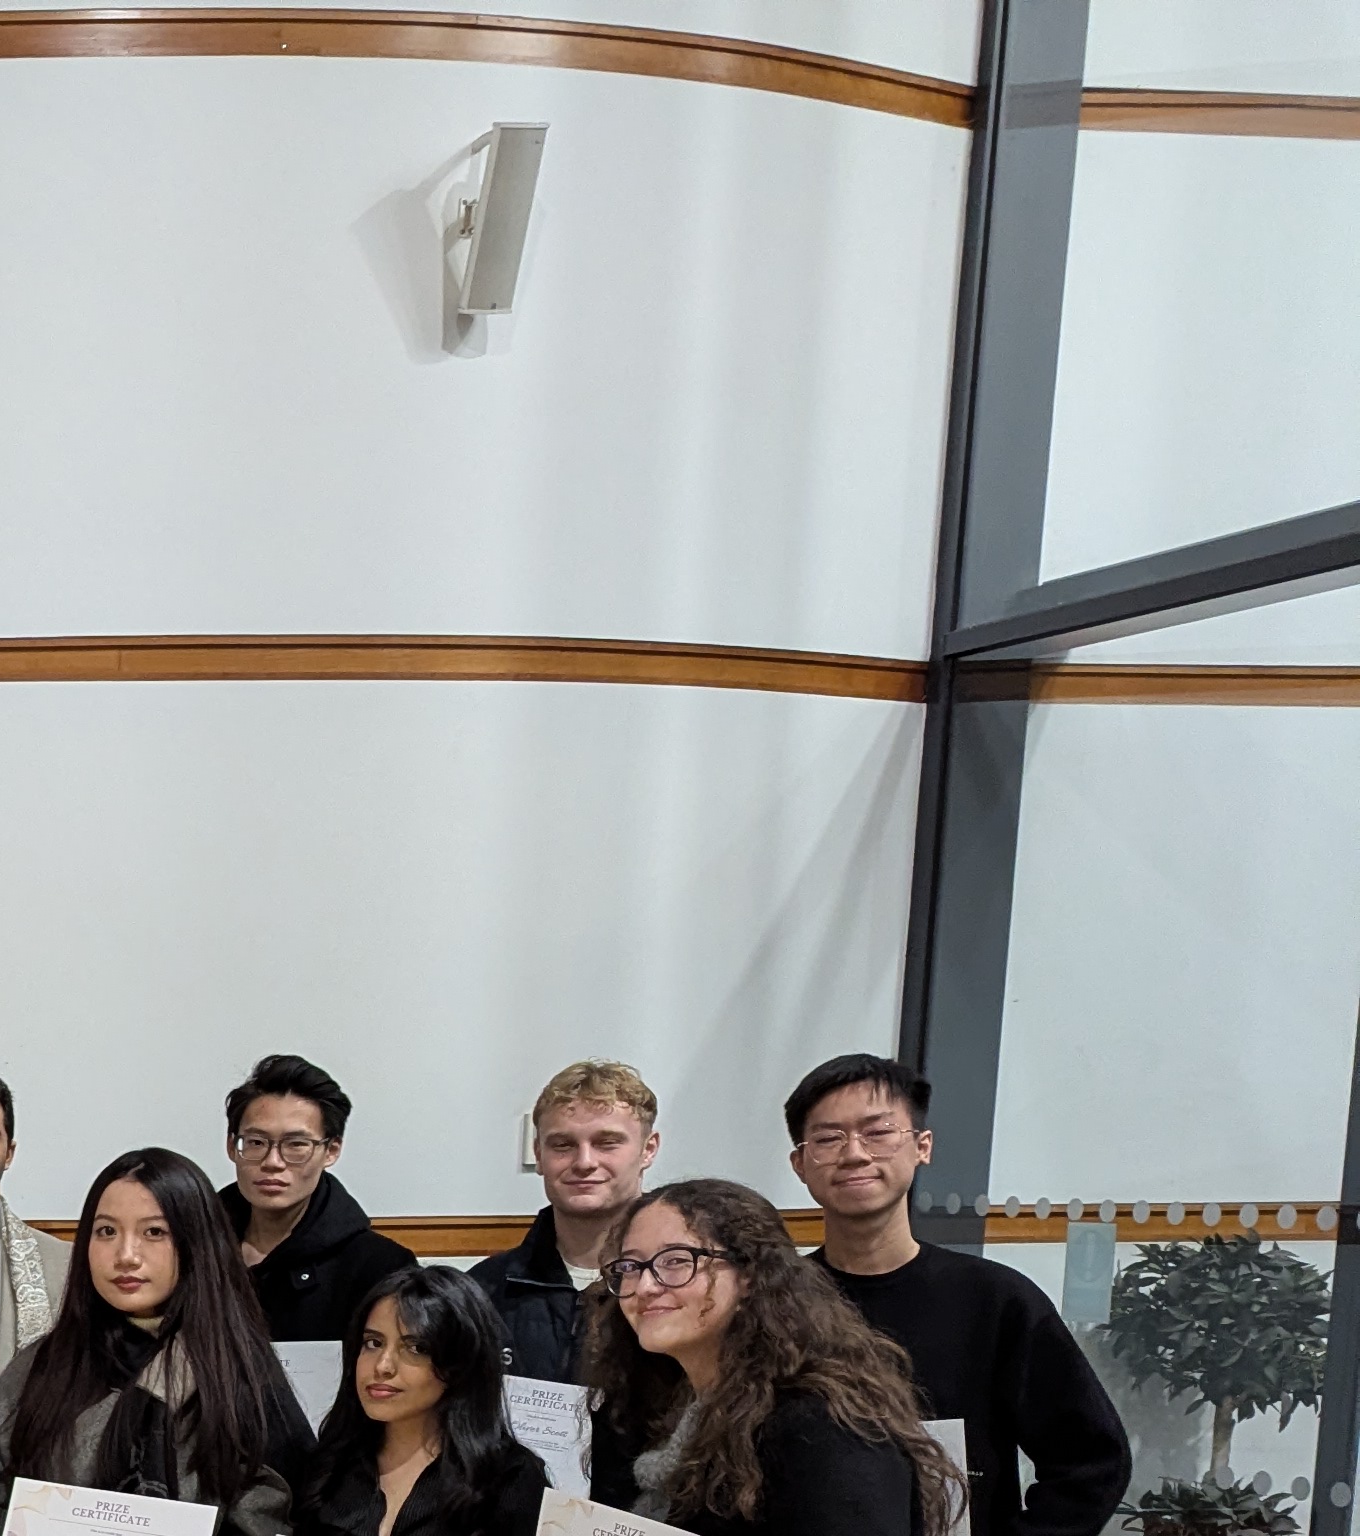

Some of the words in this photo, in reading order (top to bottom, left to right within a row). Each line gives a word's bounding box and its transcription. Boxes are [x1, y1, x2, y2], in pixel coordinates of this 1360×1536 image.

[532, 1389, 564, 1401] PRIZE
[95, 1500, 131, 1514] PRIZE
[71, 1507, 151, 1527] CERTIFICATE
